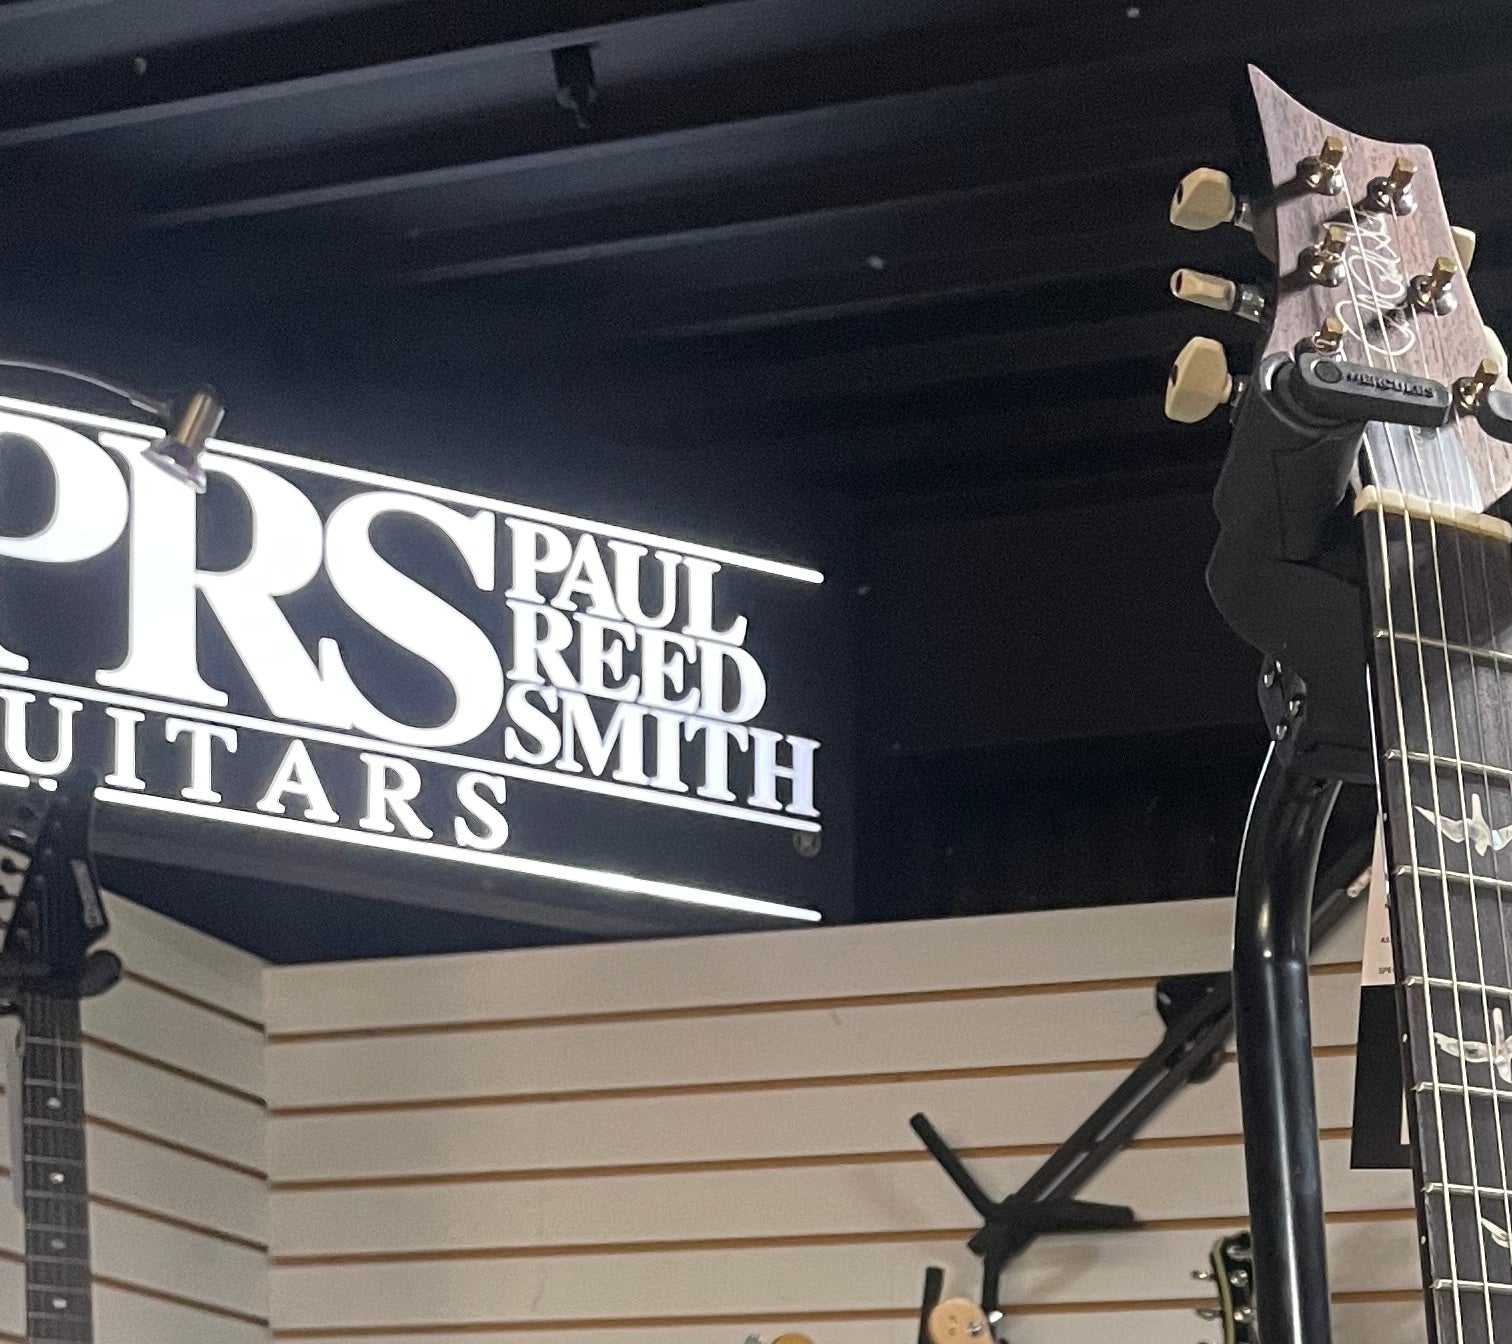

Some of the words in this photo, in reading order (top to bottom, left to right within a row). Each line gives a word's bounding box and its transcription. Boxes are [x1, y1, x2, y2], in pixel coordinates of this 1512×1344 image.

[0, 410, 506, 748] PRS
[504, 516, 748, 647] PAUL
[505, 598, 767, 724] REED
[0, 691, 509, 852] UITARS
[504, 681, 822, 817] SMITH
